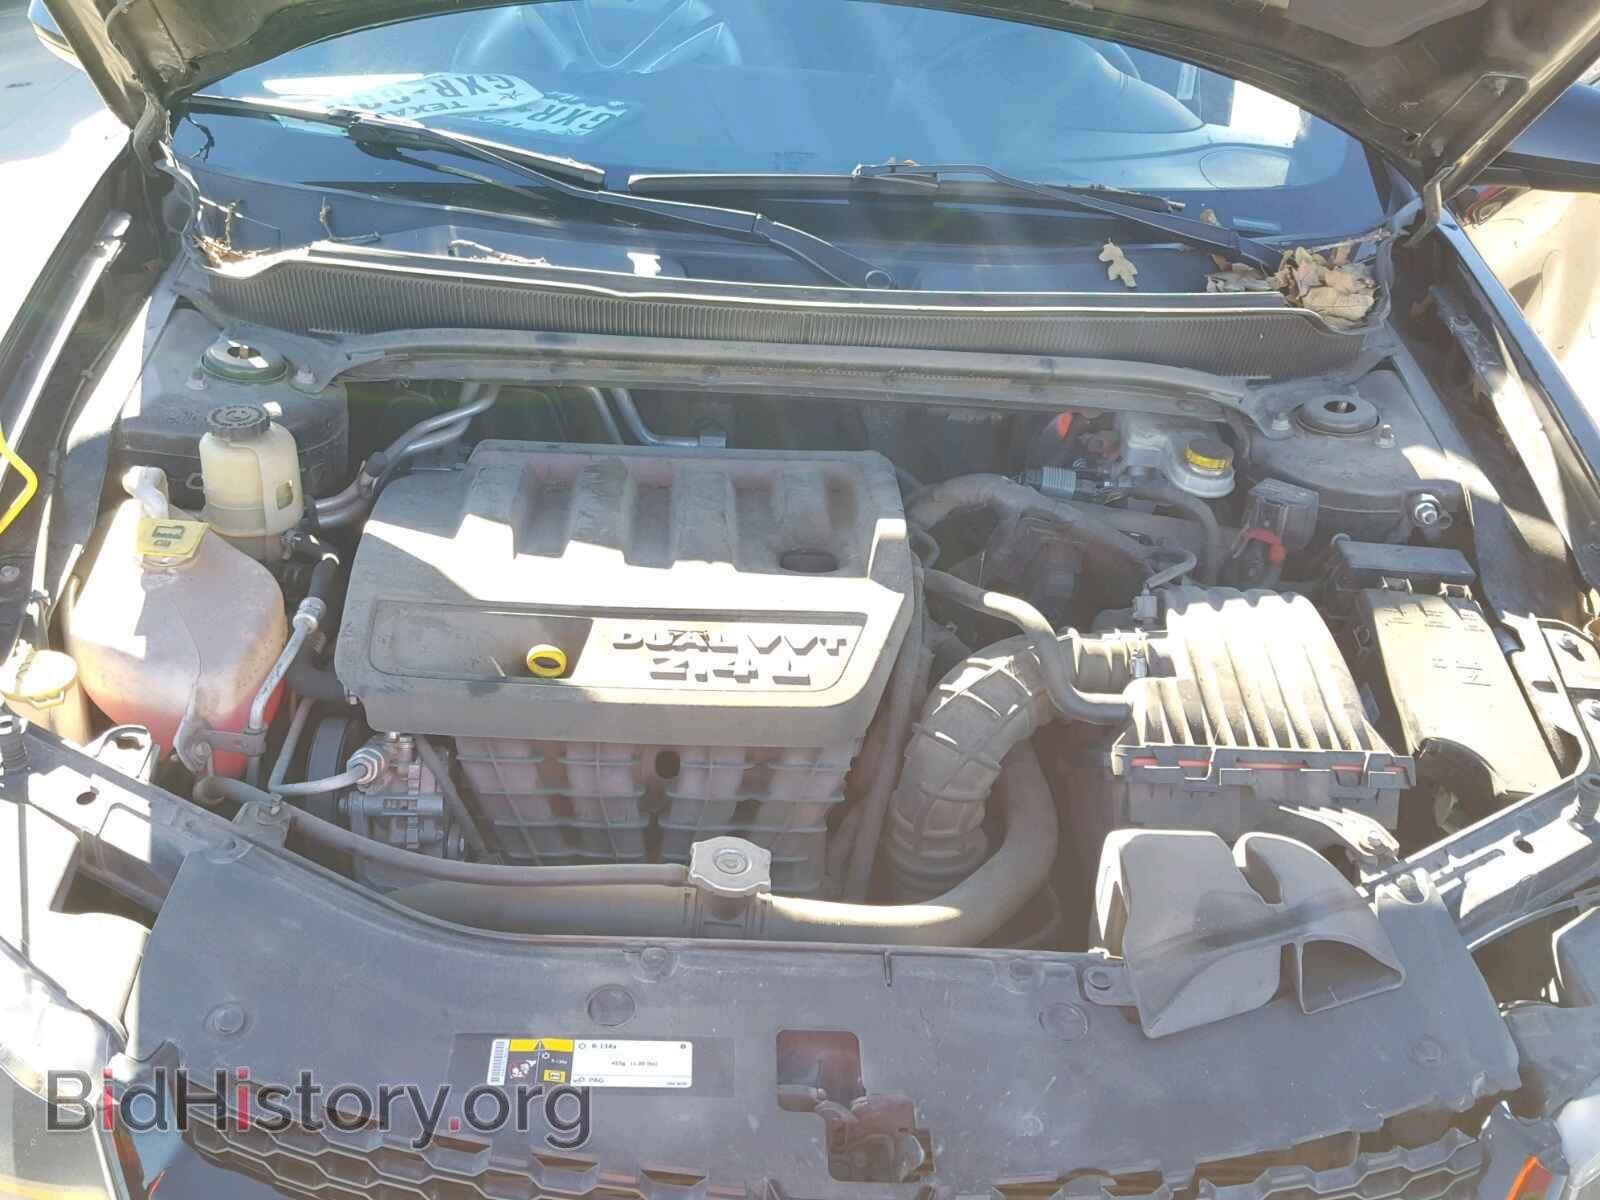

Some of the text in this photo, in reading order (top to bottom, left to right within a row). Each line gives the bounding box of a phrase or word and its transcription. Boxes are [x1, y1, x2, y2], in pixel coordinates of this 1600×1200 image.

[379, 100, 469, 117] TEXA
[611, 629, 739, 654] DUAL
[649, 656, 812, 686] 2.4L
